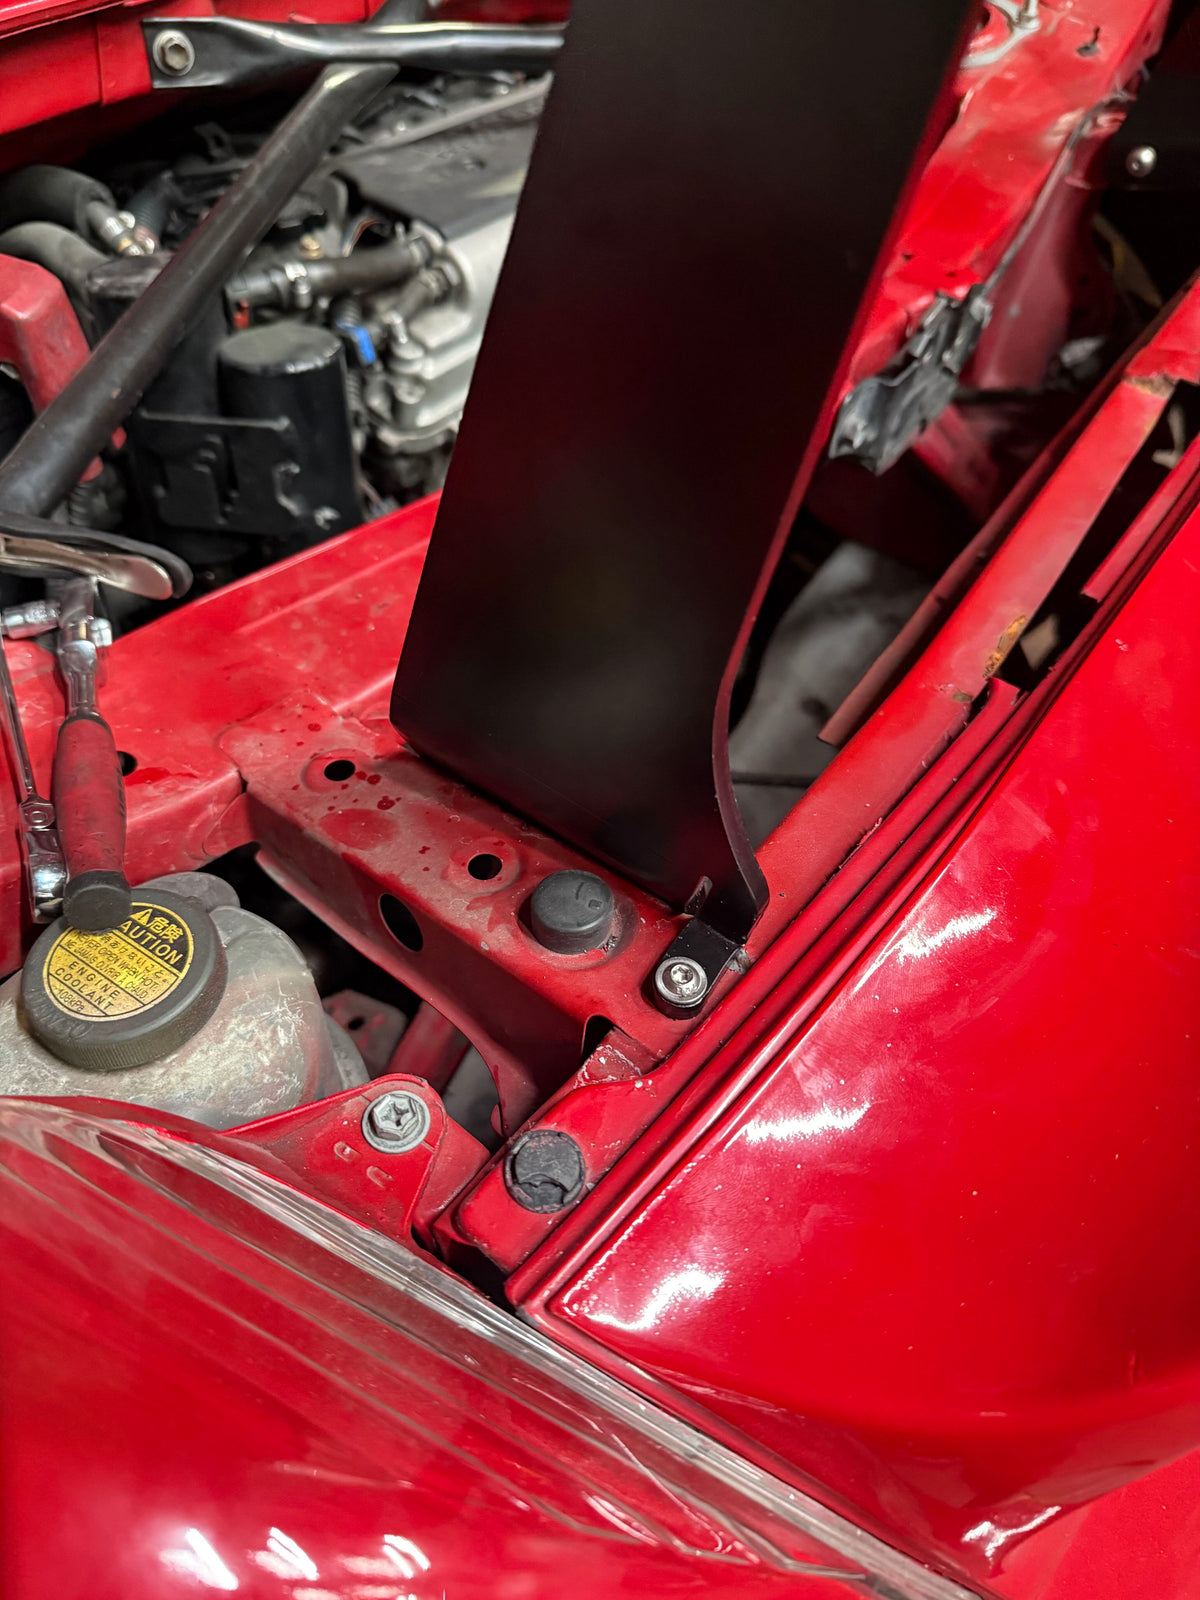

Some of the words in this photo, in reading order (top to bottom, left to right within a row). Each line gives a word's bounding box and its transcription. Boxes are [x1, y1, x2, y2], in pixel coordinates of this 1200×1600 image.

[117, 920, 183, 965] AUTION
[146, 917, 183, 943] 危険
[68, 960, 120, 999] ENGINE
[97, 946, 121, 964] OPEN
[117, 960, 141, 978] WHEN
[55, 967, 114, 1010] COOLANT
[57, 988, 85, 1012] 108kPa
